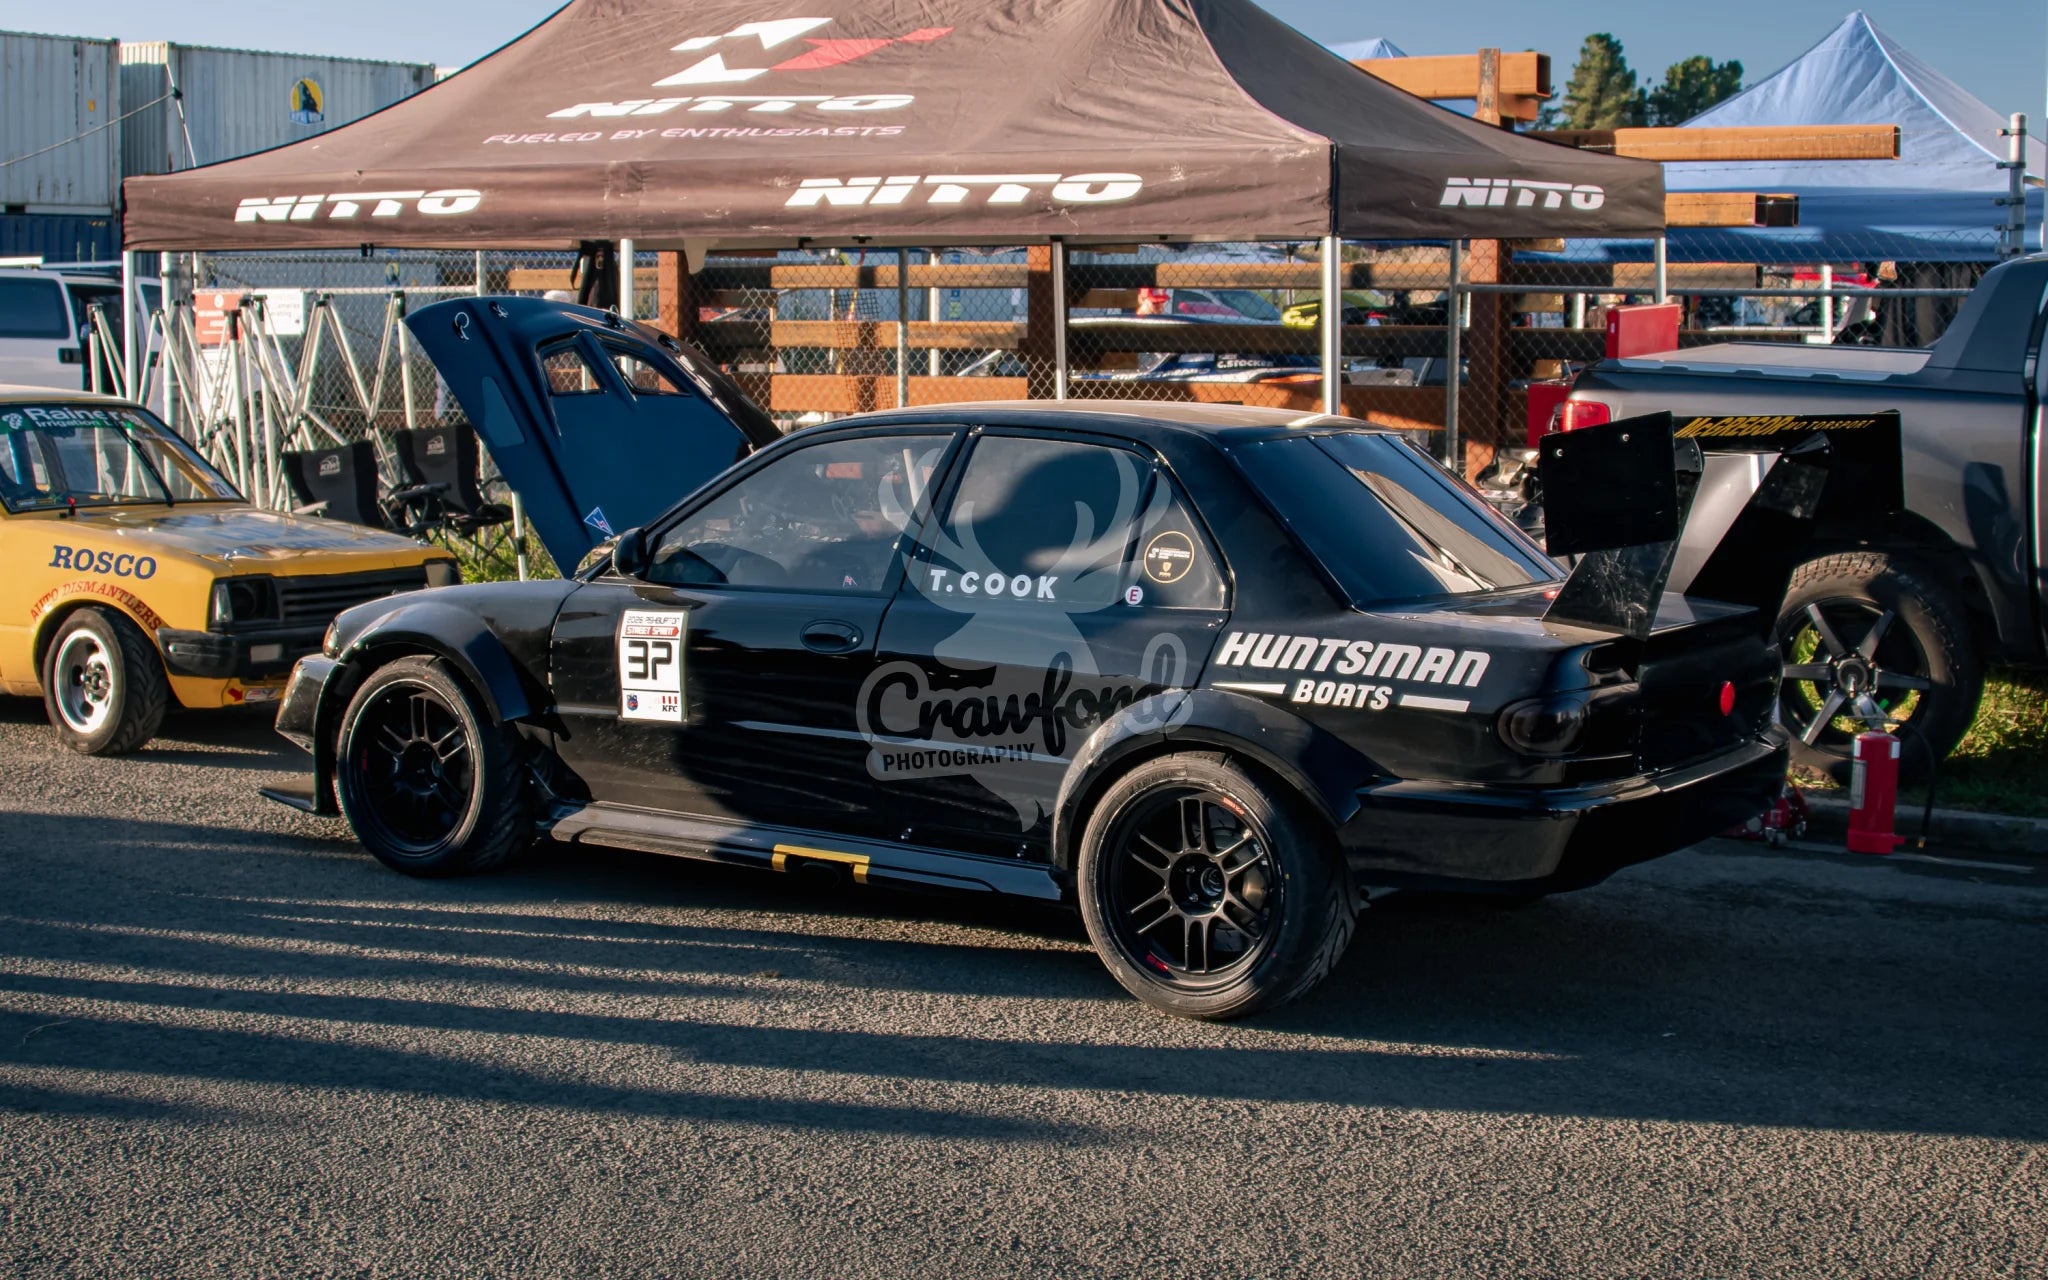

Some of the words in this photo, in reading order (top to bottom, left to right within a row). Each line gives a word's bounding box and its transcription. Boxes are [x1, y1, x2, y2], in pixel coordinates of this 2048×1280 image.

[546, 94, 915, 118] NITTO
[482, 132, 601, 145] FUELED
[610, 128, 658, 140] BY
[660, 125, 907, 139] ENTHUSIASTS
[784, 172, 1144, 207] NITTO
[1439, 177, 1605, 210] NITTO
[234, 188, 482, 222] NITTO
[23, 407, 121, 422] Rainer
[35, 419, 101, 428] Irrigation
[1673, 416, 1796, 438] McGREGOR
[48, 544, 157, 580] ROSCO
[30, 588, 59, 621] AUTO
[62, 580, 162, 630] DISMANTLERS
[1129, 588, 1139, 602] E
[1215, 631, 1491, 688] HUNTSMAN
[1292, 678, 1393, 711] BOATS
[661, 705, 678, 713] KFC
